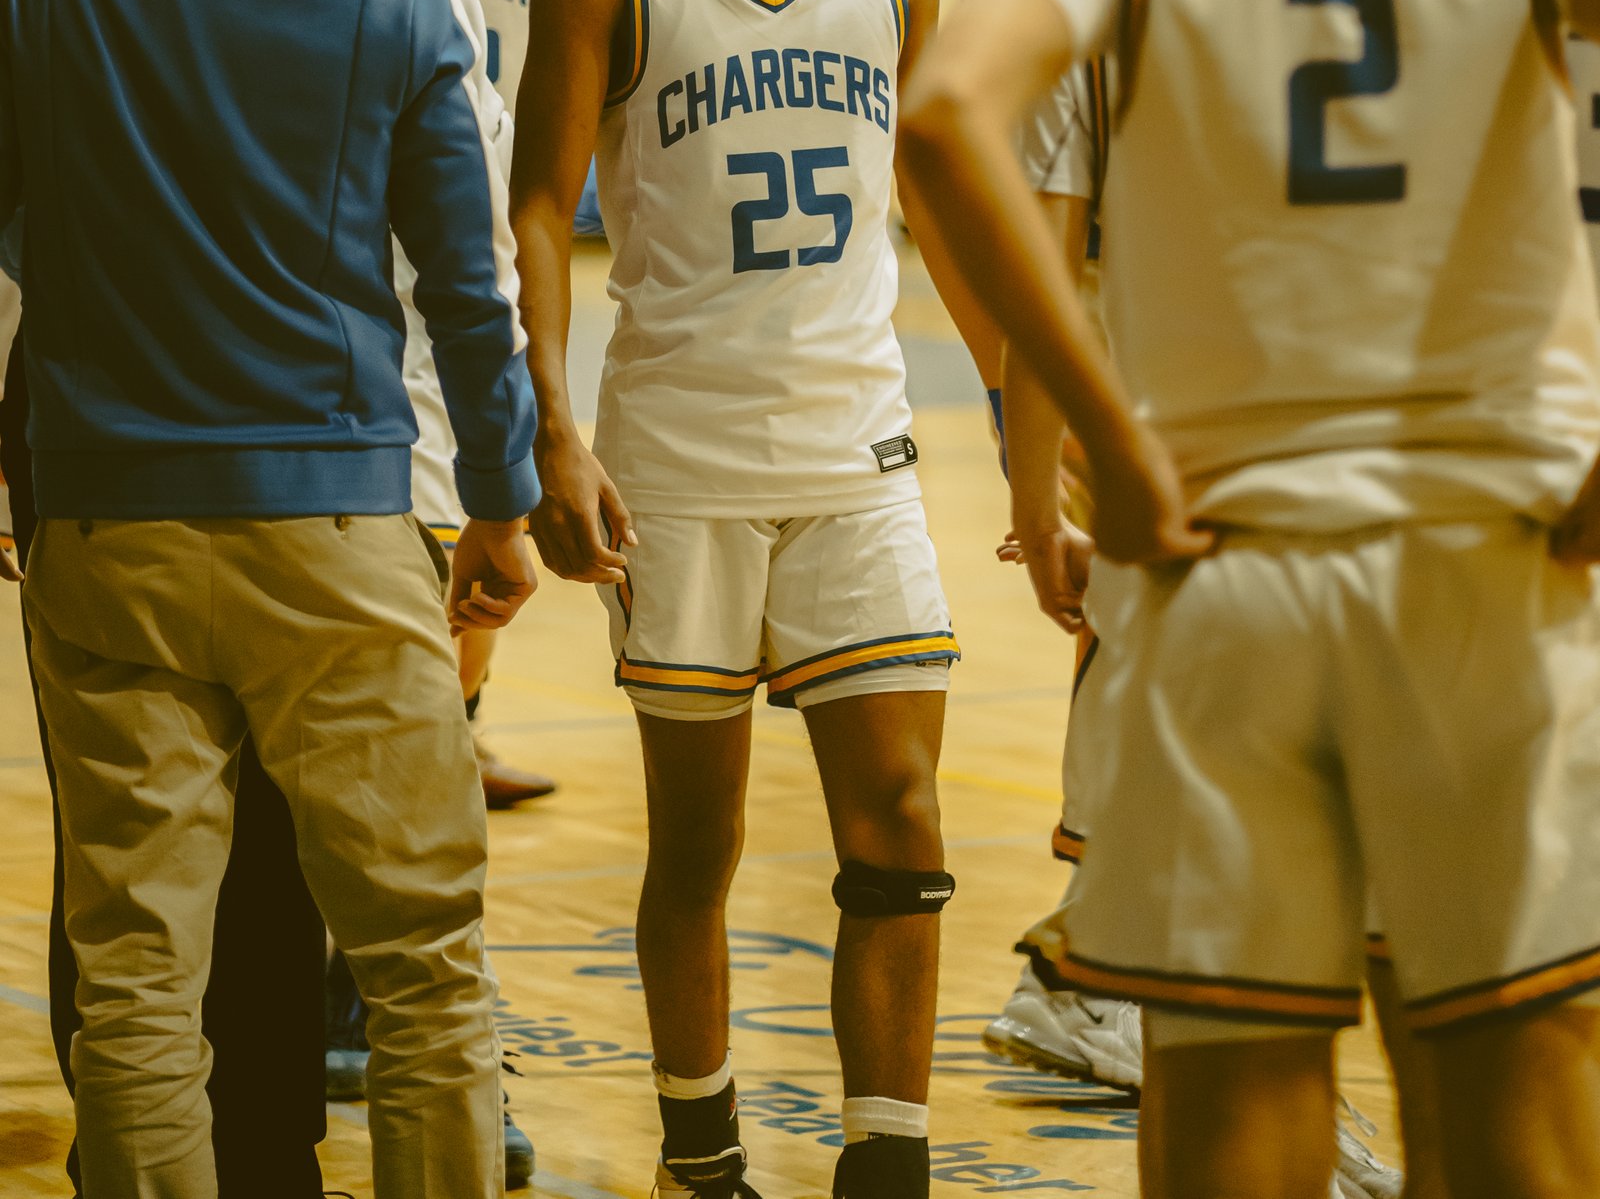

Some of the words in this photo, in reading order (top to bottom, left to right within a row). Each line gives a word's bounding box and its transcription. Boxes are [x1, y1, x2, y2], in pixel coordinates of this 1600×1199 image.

[657, 48, 890, 149] CHARGERS
[726, 146, 853, 275] 25
[906, 443, 914, 456] S
